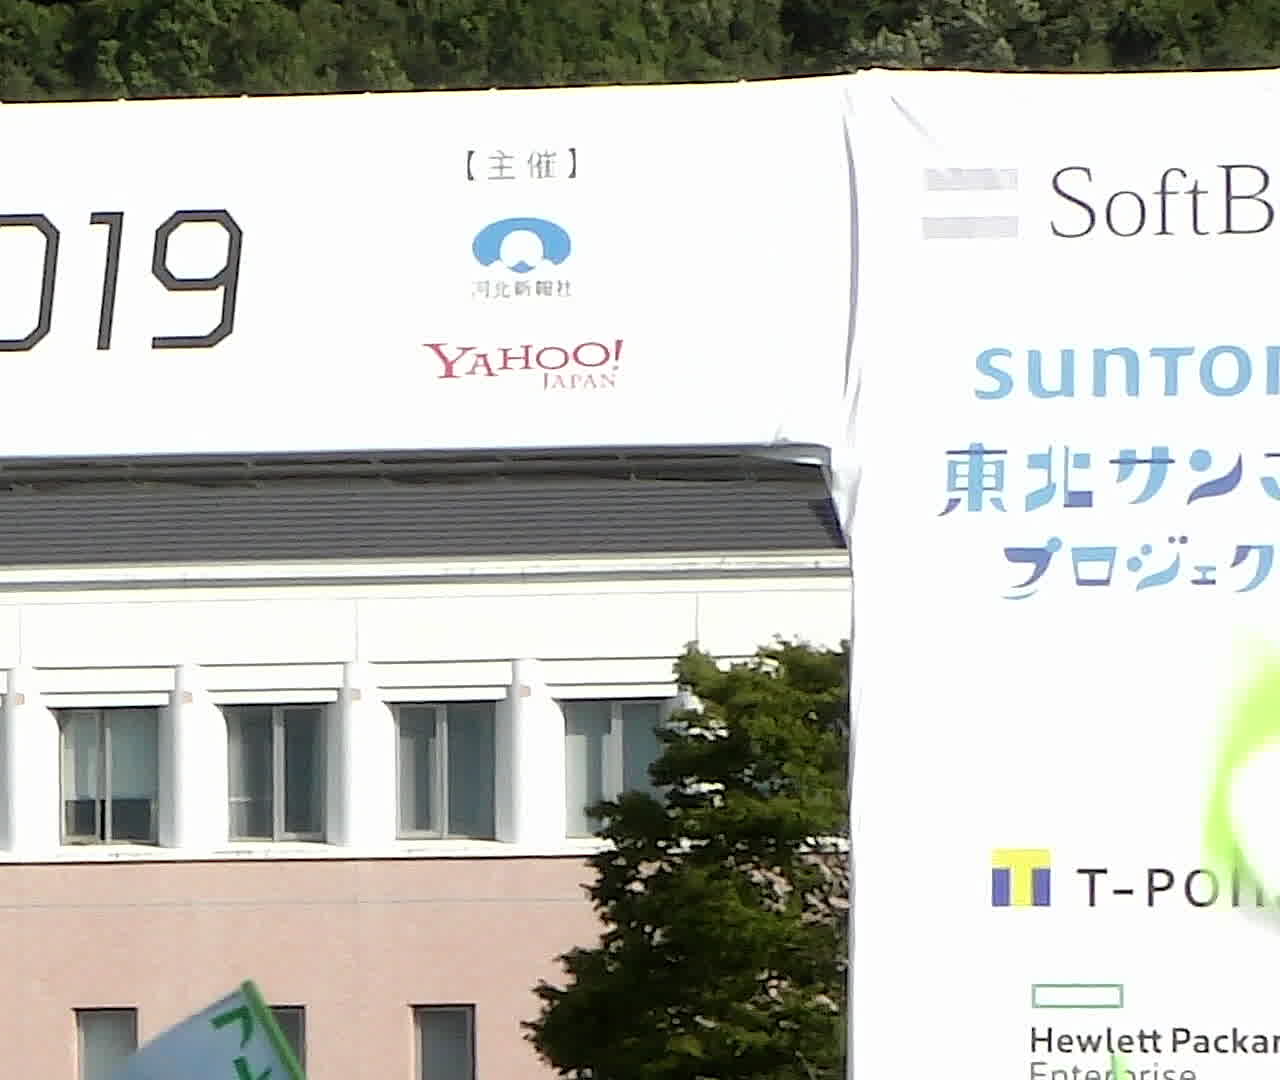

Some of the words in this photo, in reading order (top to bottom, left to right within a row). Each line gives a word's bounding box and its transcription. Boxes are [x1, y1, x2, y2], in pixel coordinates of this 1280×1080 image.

[1050, 165, 1274, 238] SoftB
[421, 338, 624, 379] YAHOO!
[543, 373, 615, 390] JAPAN
[1031, 1027, 1162, 1053] Hewlett
